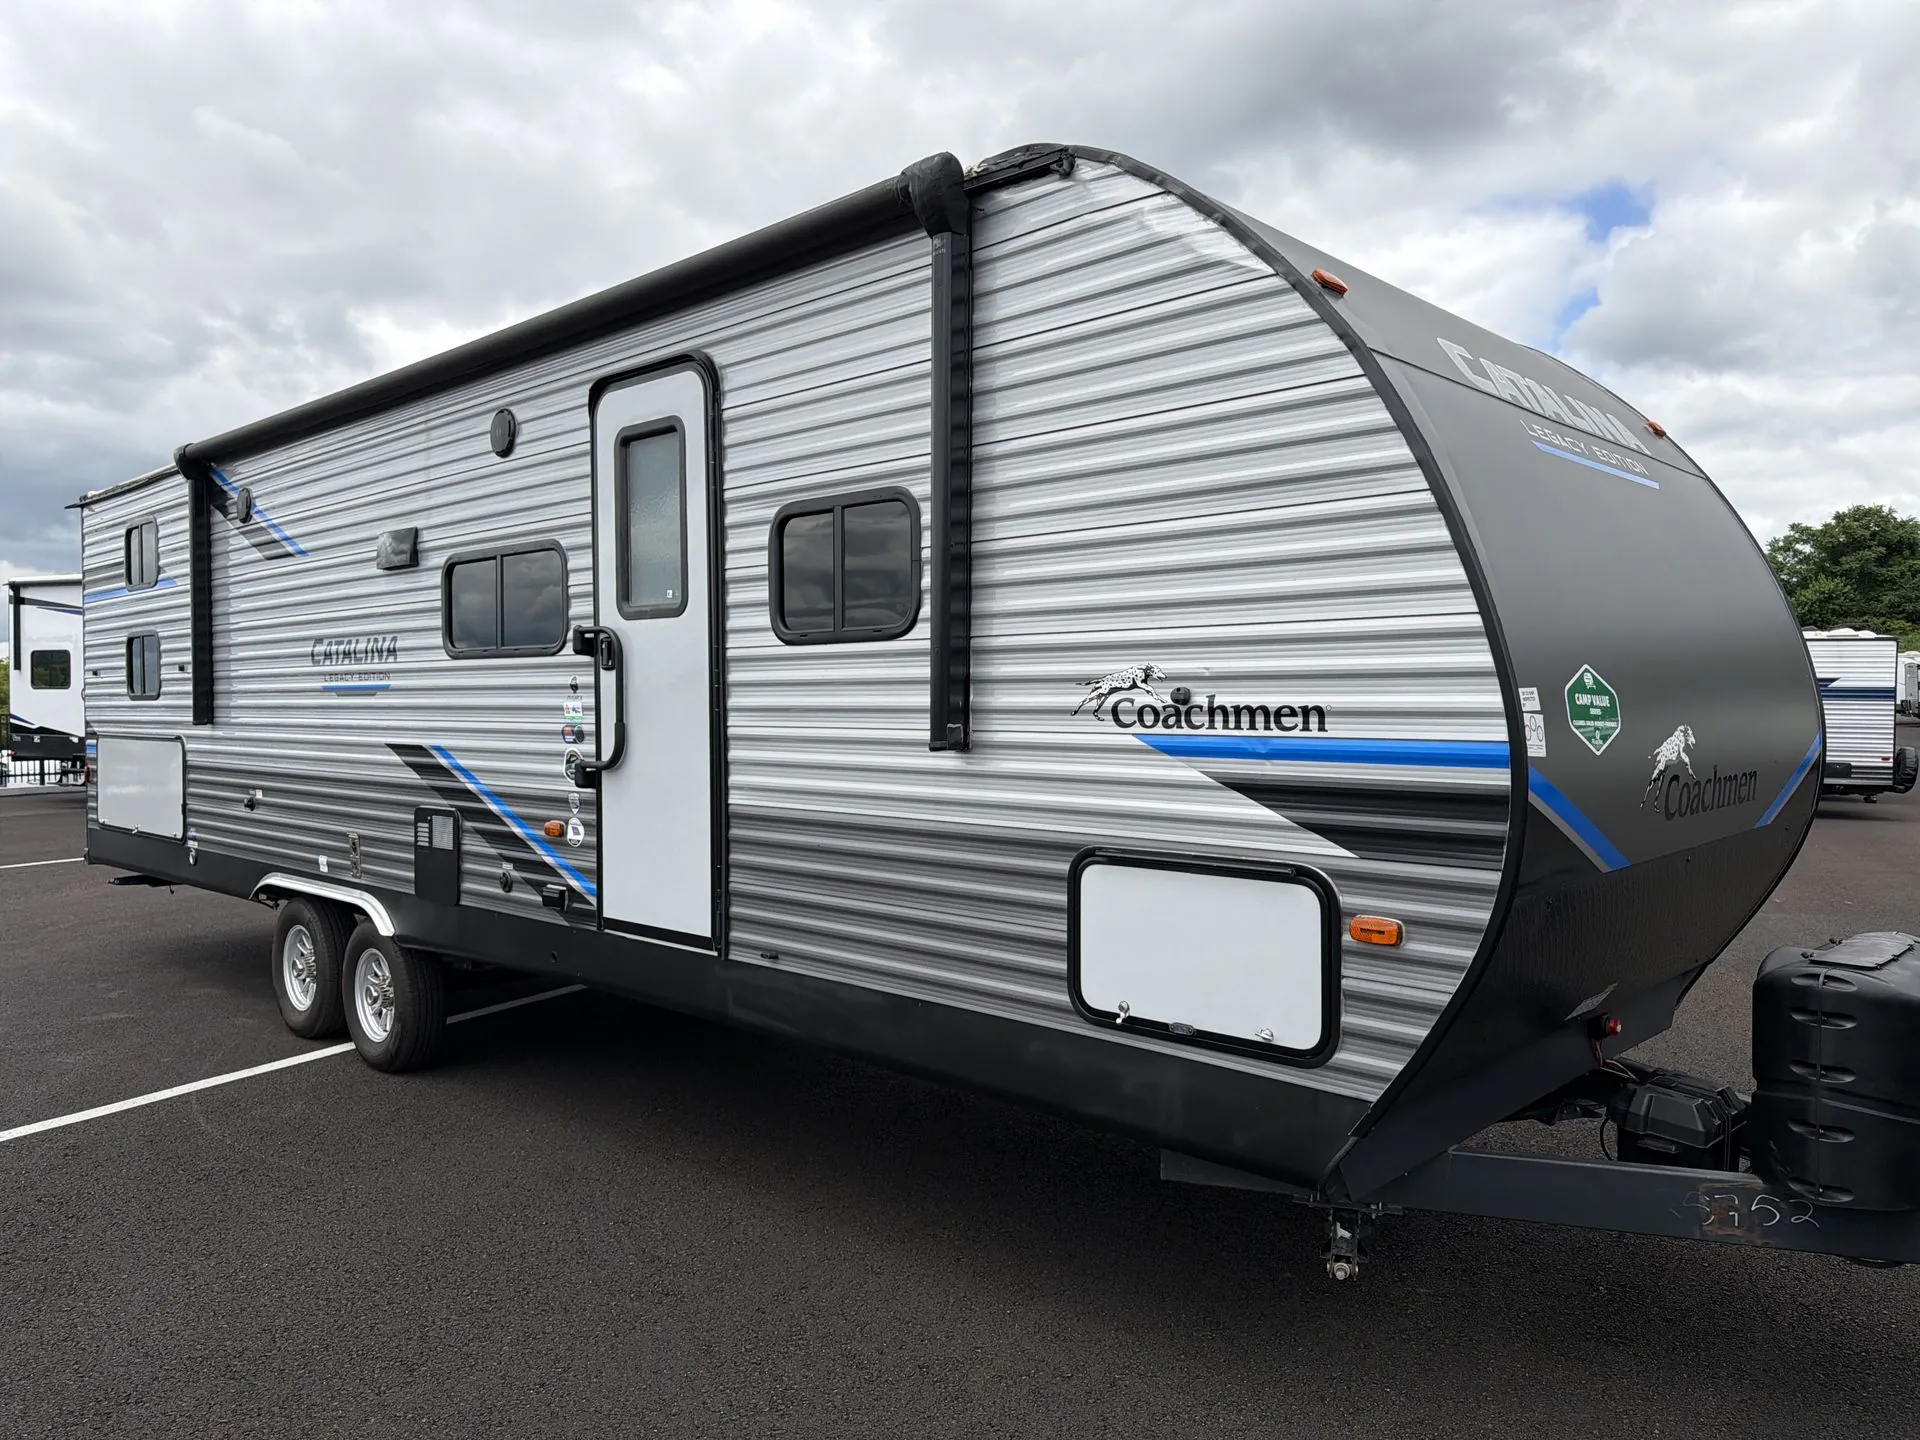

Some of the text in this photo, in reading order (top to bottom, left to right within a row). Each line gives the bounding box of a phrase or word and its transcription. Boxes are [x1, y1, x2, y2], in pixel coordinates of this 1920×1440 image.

[1436, 337, 1651, 455] CATALINA
[1519, 419, 1649, 475] LEGACY EDITION
[310, 636, 398, 665] CATALINA
[323, 672, 391, 682] LEGACY EDITION
[1110, 694, 1329, 732] Coachmen
[1574, 693, 1611, 707] CAMP VALUE
[1664, 764, 1757, 821] Coachmen
